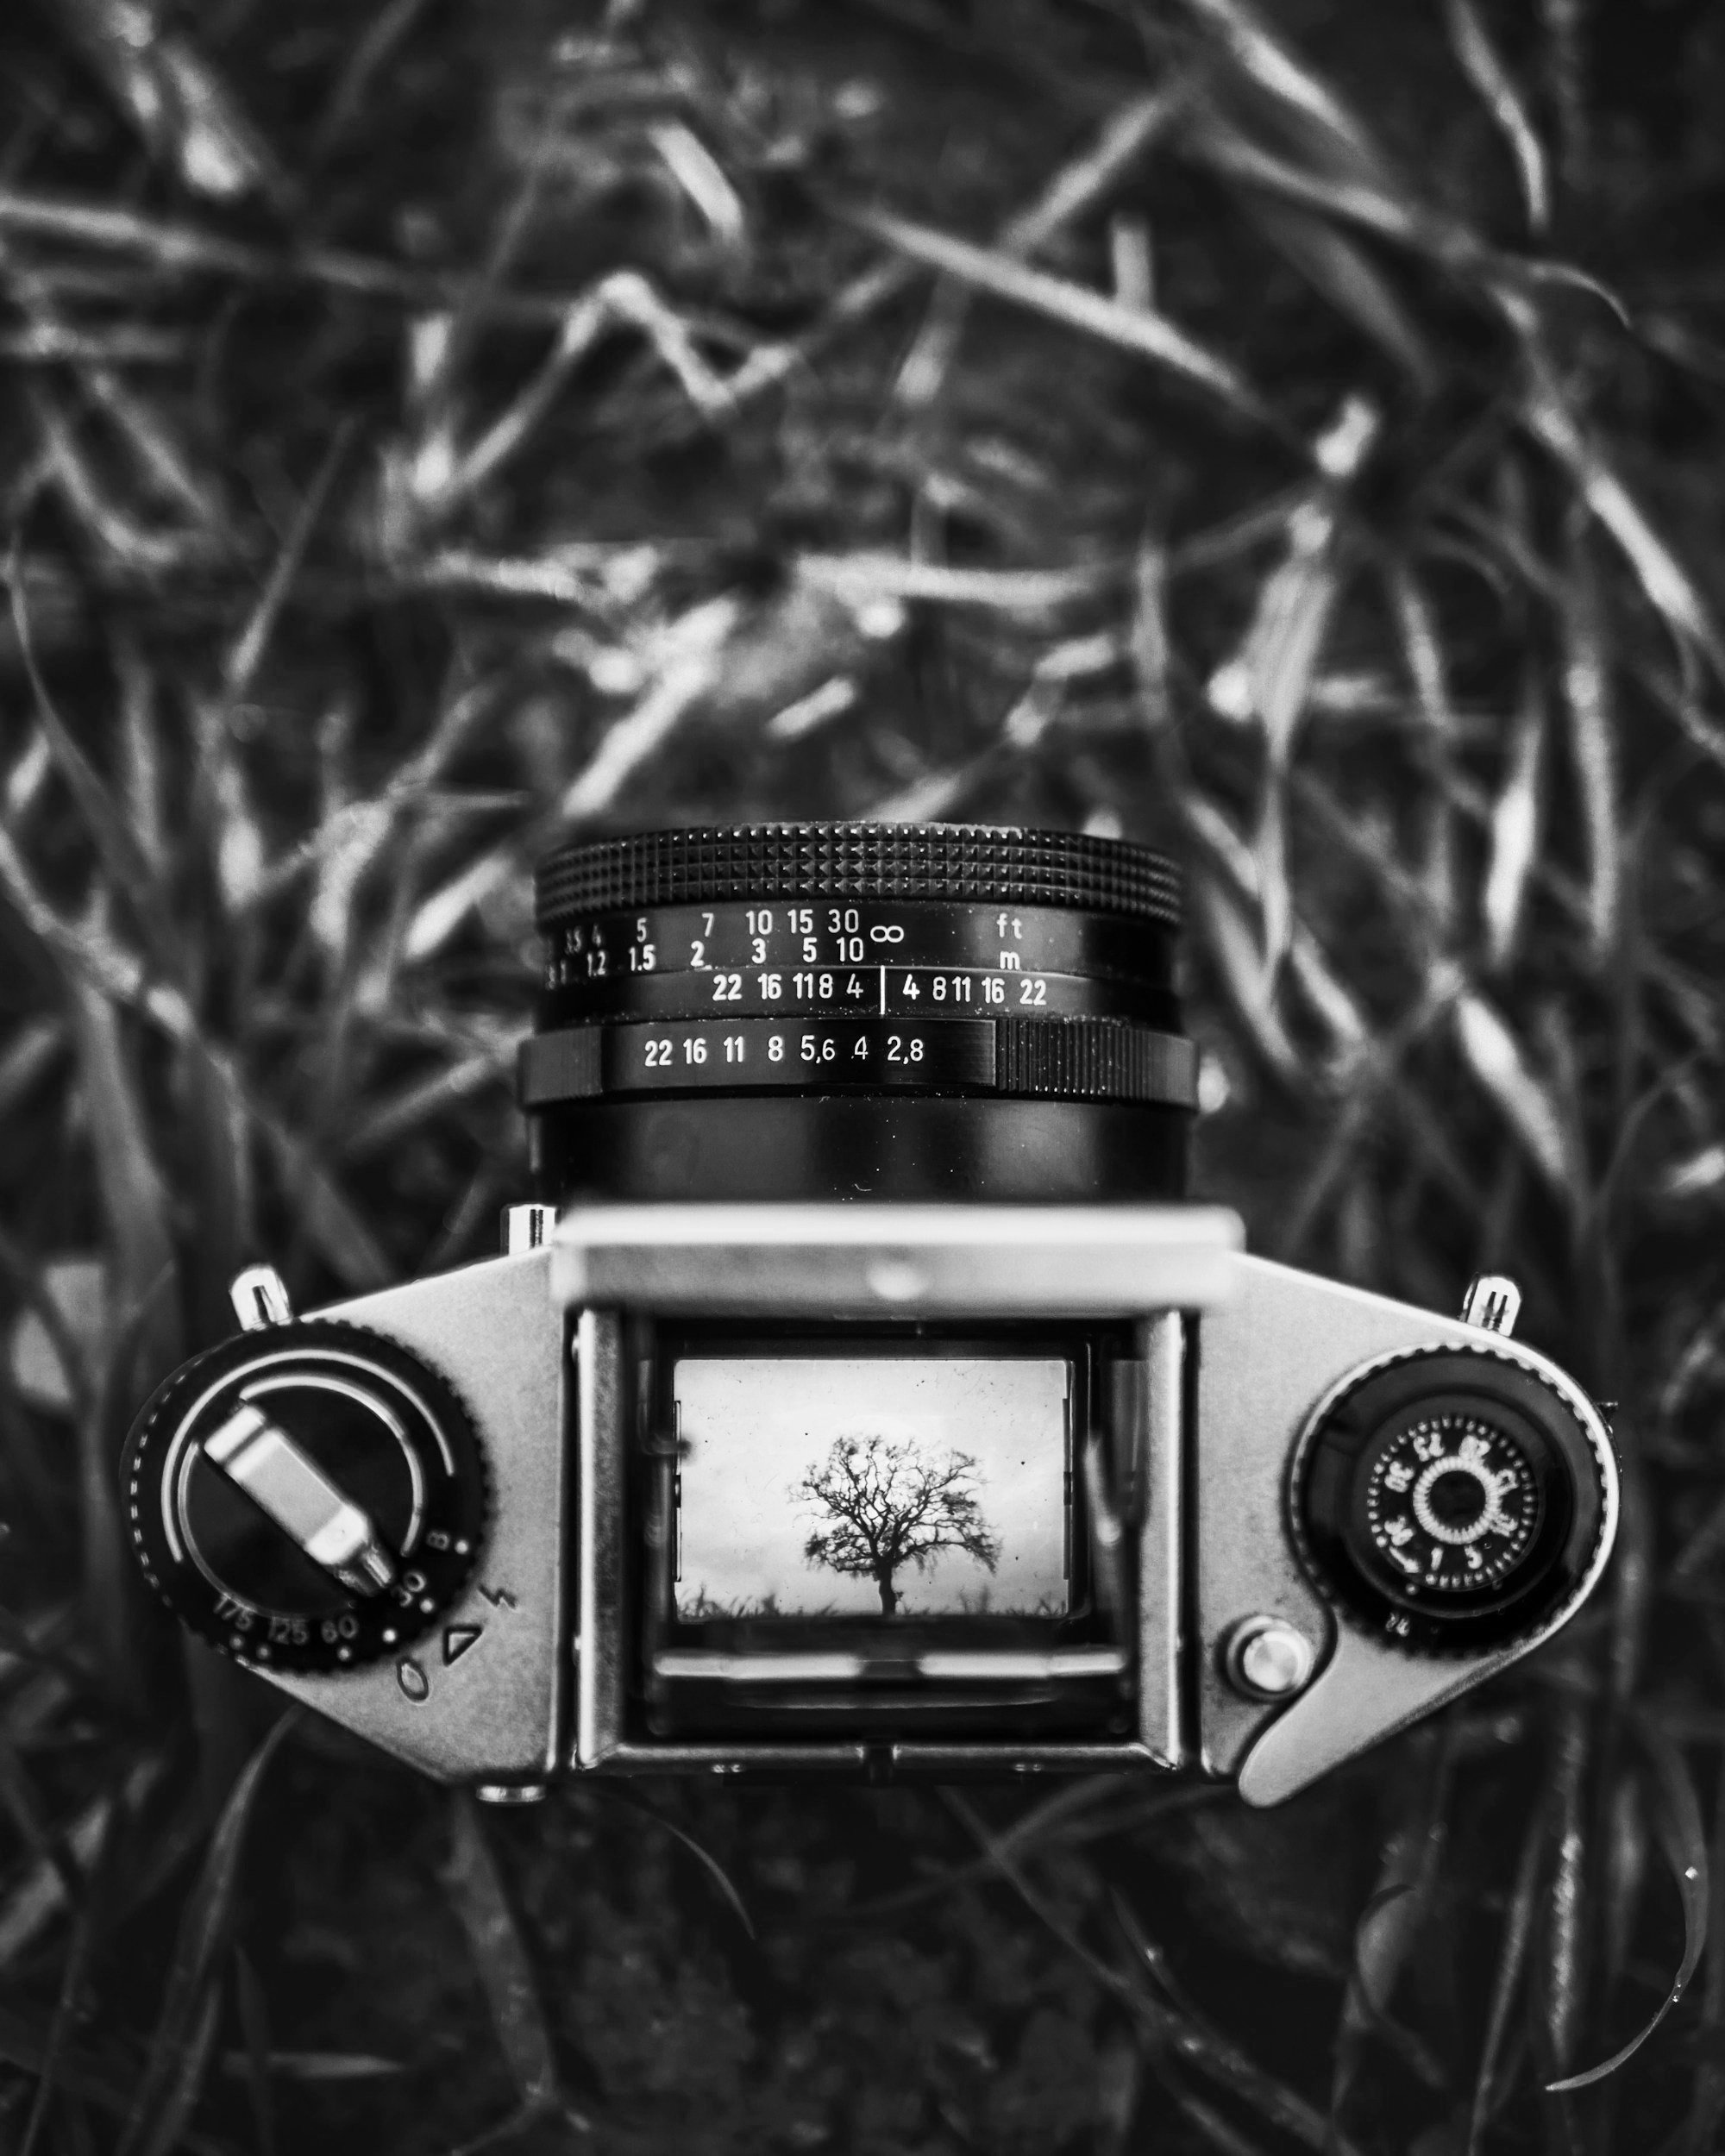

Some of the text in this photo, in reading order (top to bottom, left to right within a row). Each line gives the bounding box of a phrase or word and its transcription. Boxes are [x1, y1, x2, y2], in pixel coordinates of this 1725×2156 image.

[636, 917, 648, 943] 5
[701, 912, 714, 937] 7
[745, 909, 773, 936] 10
[787, 908, 813, 934] 15
[827, 908, 859, 934] 30
[586, 949, 607, 978] 1.2
[629, 943, 656, 972] 1.5
[690, 940, 705, 967] 2
[751, 937, 767, 964] 3
[802, 937, 818, 963] 5
[836, 937, 864, 962] 10
[999, 950, 1020, 970] m
[712, 974, 743, 1001] 22
[757, 973, 782, 1000] 16
[846, 973, 864, 999] 4
[902, 974, 920, 1000] 4
[932, 976, 947, 1001] 8
[951, 976, 971, 1003] 11
[981, 976, 1006, 1004] 16
[1019, 978, 1046, 1006] 22
[644, 1034, 924, 1067] 22 16 11 8 5,6 4 2,8
[1429, 1546, 1444, 1572] 1
[1465, 1546, 1483, 1570] 5
